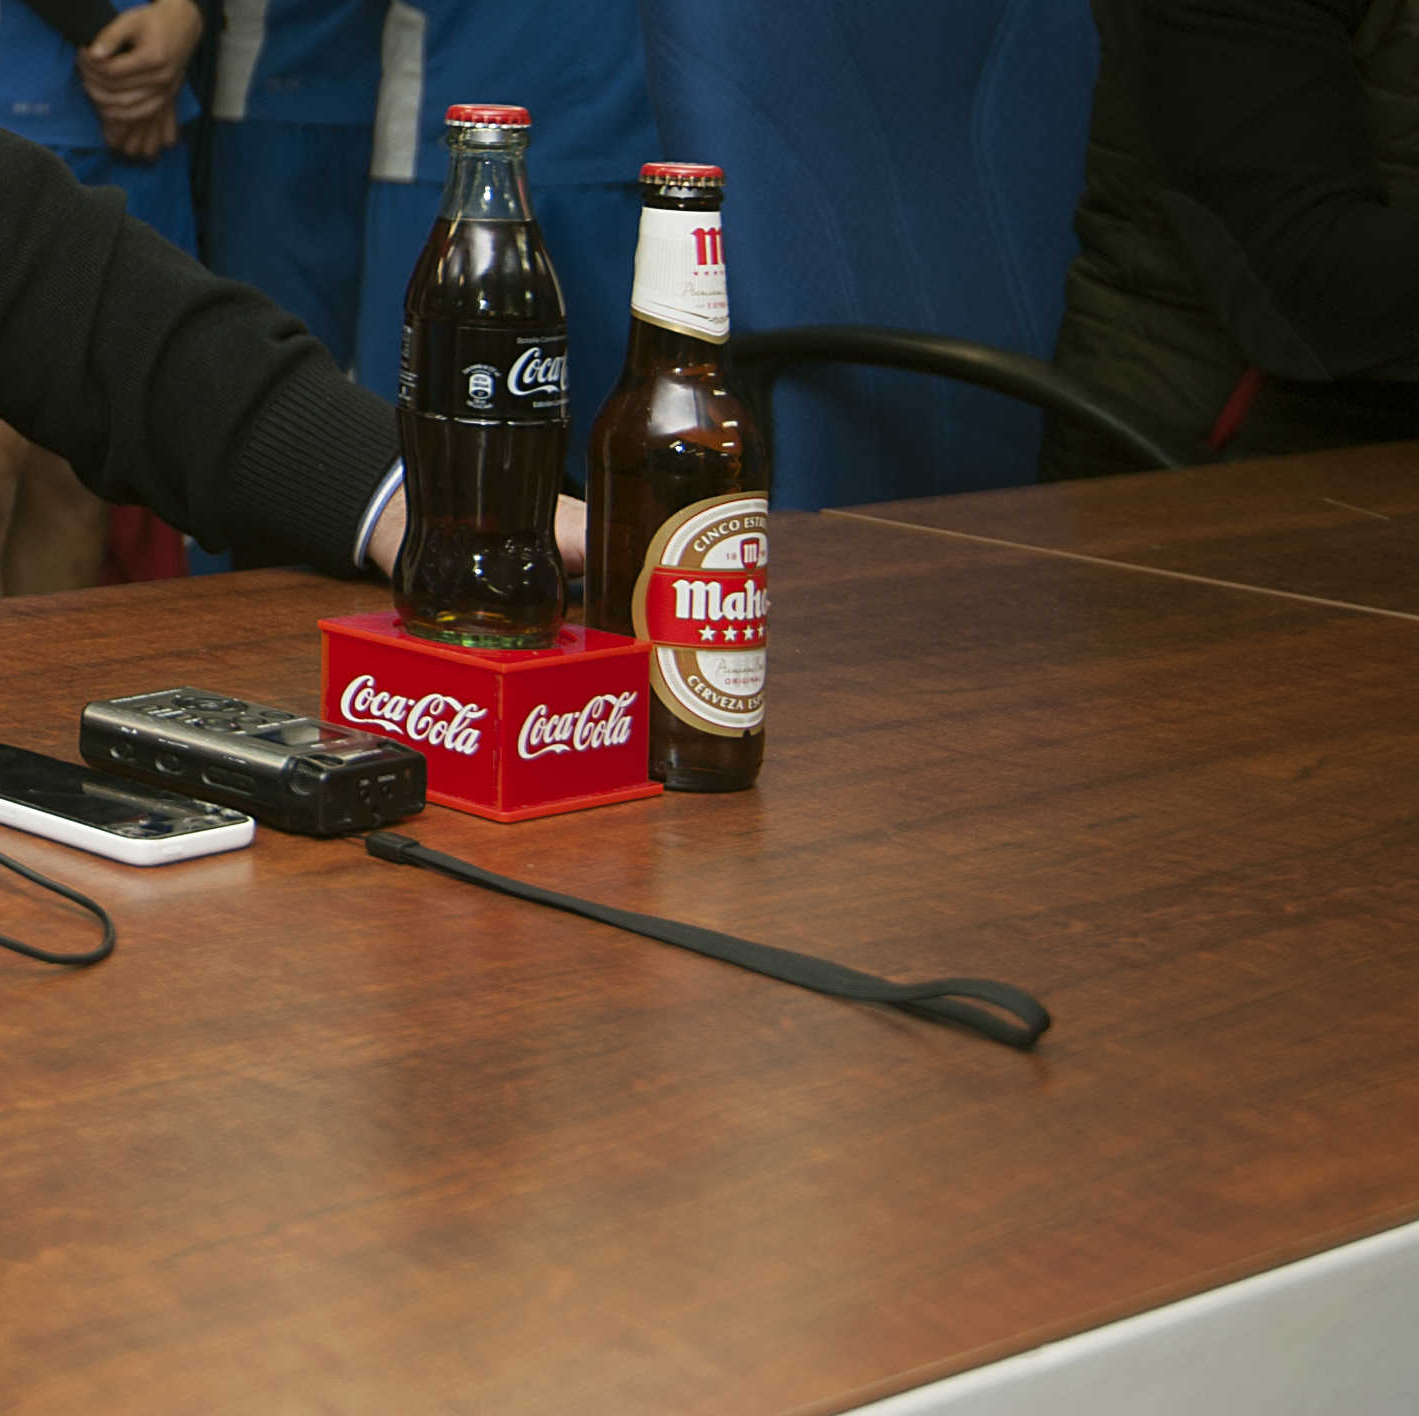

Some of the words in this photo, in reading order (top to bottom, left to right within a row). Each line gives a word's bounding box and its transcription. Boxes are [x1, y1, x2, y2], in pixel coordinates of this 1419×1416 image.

[692, 518, 741, 553] CINCO
[340, 674, 490, 757] Coca-Cola
[686, 674, 744, 711] CERVEZA
[517, 690, 639, 761] Coca-Cola
